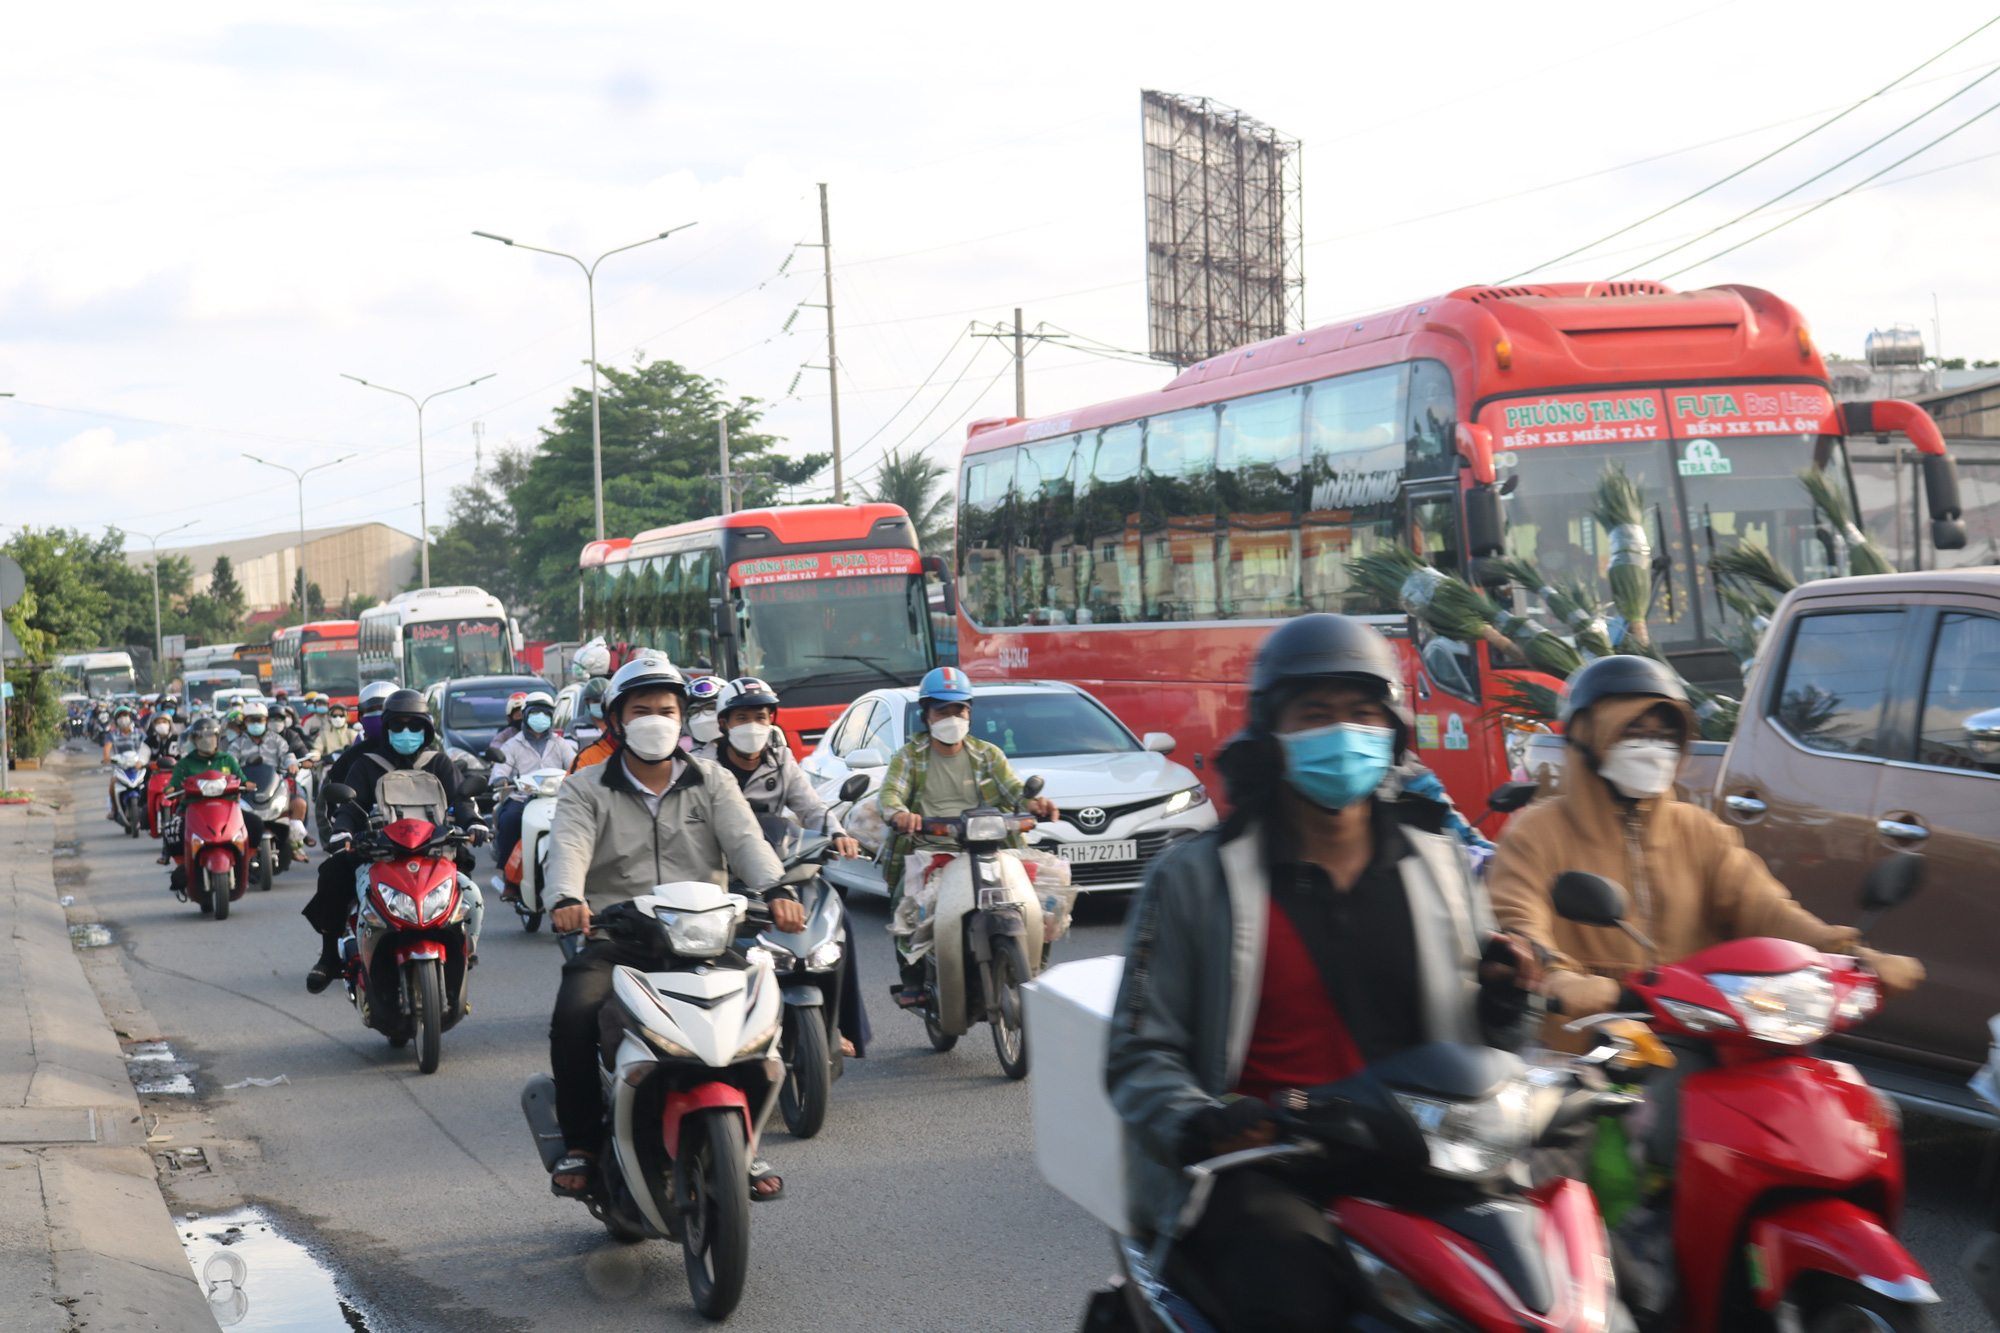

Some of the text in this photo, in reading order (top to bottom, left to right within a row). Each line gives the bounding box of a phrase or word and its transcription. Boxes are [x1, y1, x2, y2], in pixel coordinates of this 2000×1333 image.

[1505, 398, 1656, 429] PHƯƠNG TRANG
[1674, 391, 1824, 418] FUTA Bus Lines
[1502, 430, 1540, 448] BẾN
[1544, 431, 1569, 444] XE
[1620, 424, 1658, 439] TÂY
[1686, 419, 1723, 435] BẾN
[1726, 421, 1751, 433] XE
[1794, 417, 1819, 431] ÔN
[1693, 444, 1713, 458] 14
[738, 560, 781, 577] PHƯƠNG
[782, 557, 819, 572] TRANG
[831, 554, 867, 568] FUTA
[868, 553, 887, 566] Bus
[764, 575, 775, 583] XE
[856, 567, 869, 575] XE
[1061, 843, 1132, 863] 51H-727.11
